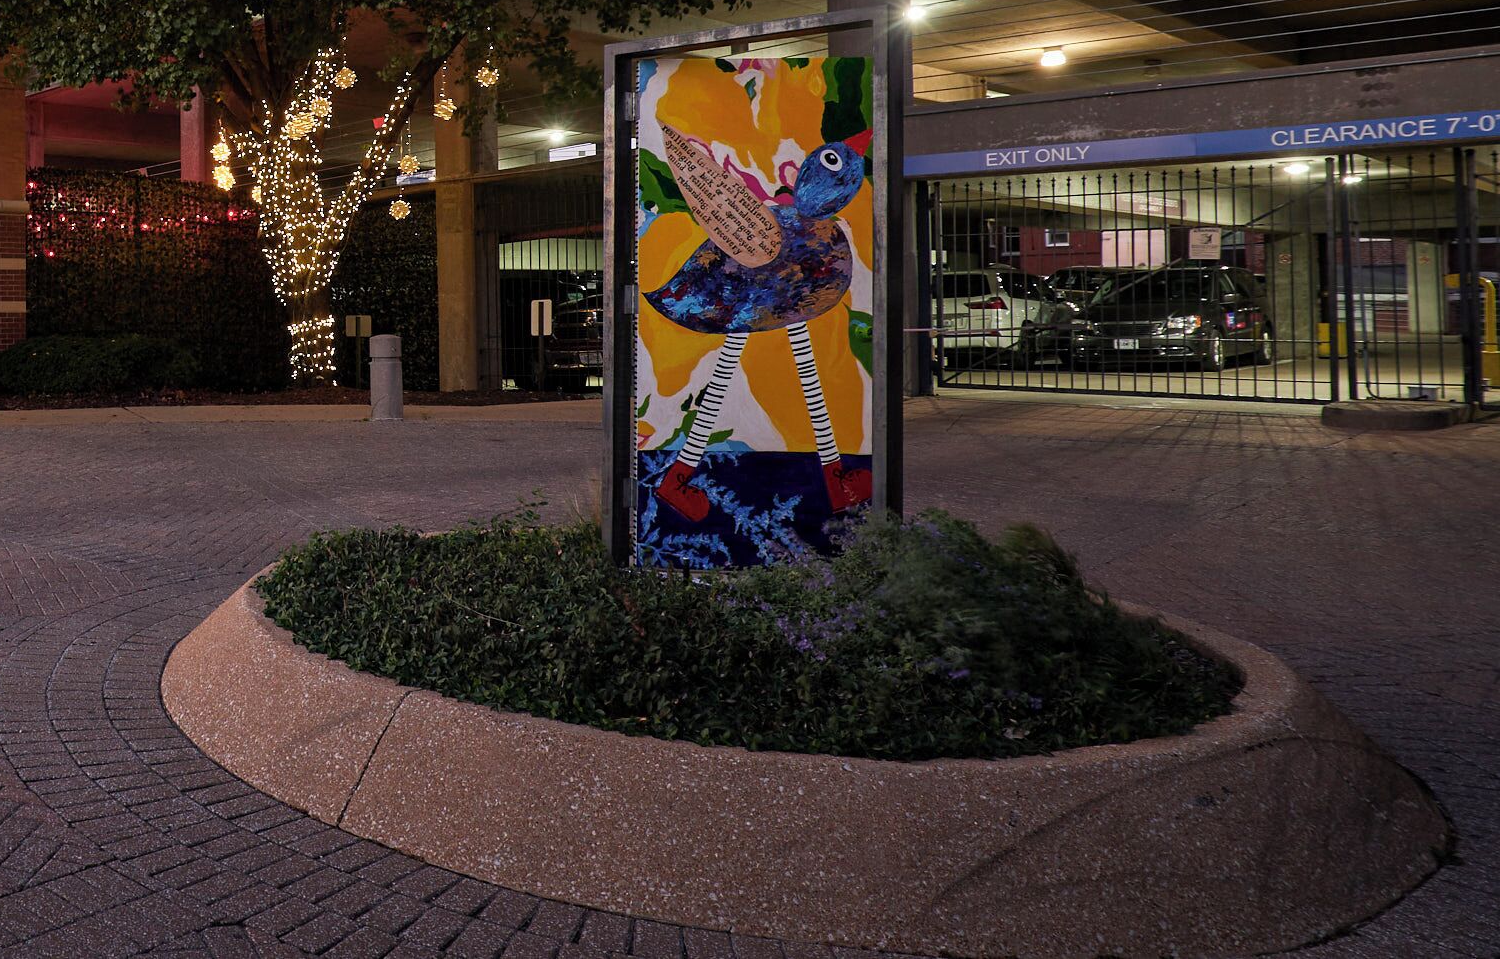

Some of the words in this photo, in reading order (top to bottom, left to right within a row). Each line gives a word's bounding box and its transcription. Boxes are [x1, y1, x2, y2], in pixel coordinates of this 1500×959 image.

[661, 125, 696, 158] resilience
[1271, 119, 1437, 146] CLEARANCE
[986, 150, 1030, 167] EXIT
[1035, 145, 1090, 163] ONLY
[689, 174, 716, 201] resilient
[732, 182, 764, 210] rebound
[691, 205, 712, 225] quick
[713, 226, 743, 256] recovery
